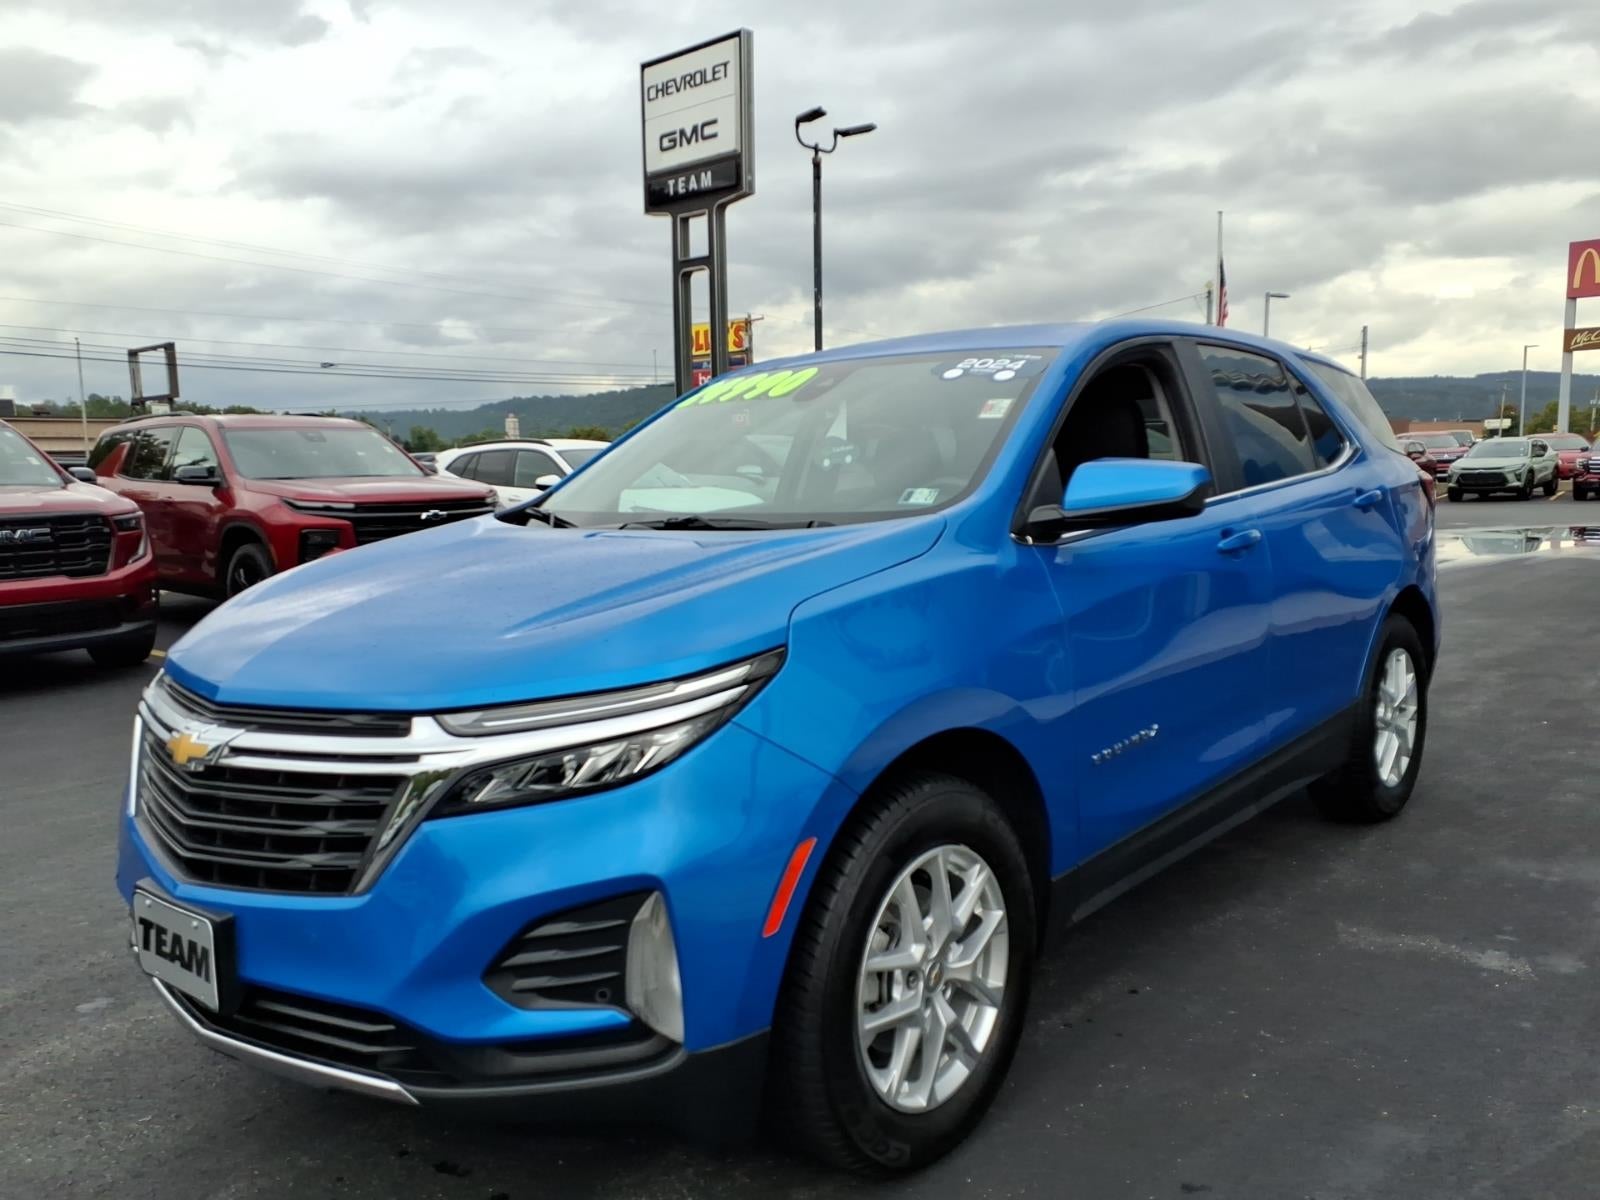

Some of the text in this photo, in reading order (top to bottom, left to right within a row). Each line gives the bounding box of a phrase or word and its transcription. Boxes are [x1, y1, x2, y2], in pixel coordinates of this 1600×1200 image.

[647, 60, 730, 103] CHEVROLET
[659, 117, 718, 152] GMC
[667, 170, 711, 197] TEAM
[956, 358, 1026, 370] 2024
[138, 917, 211, 984] TEAM
